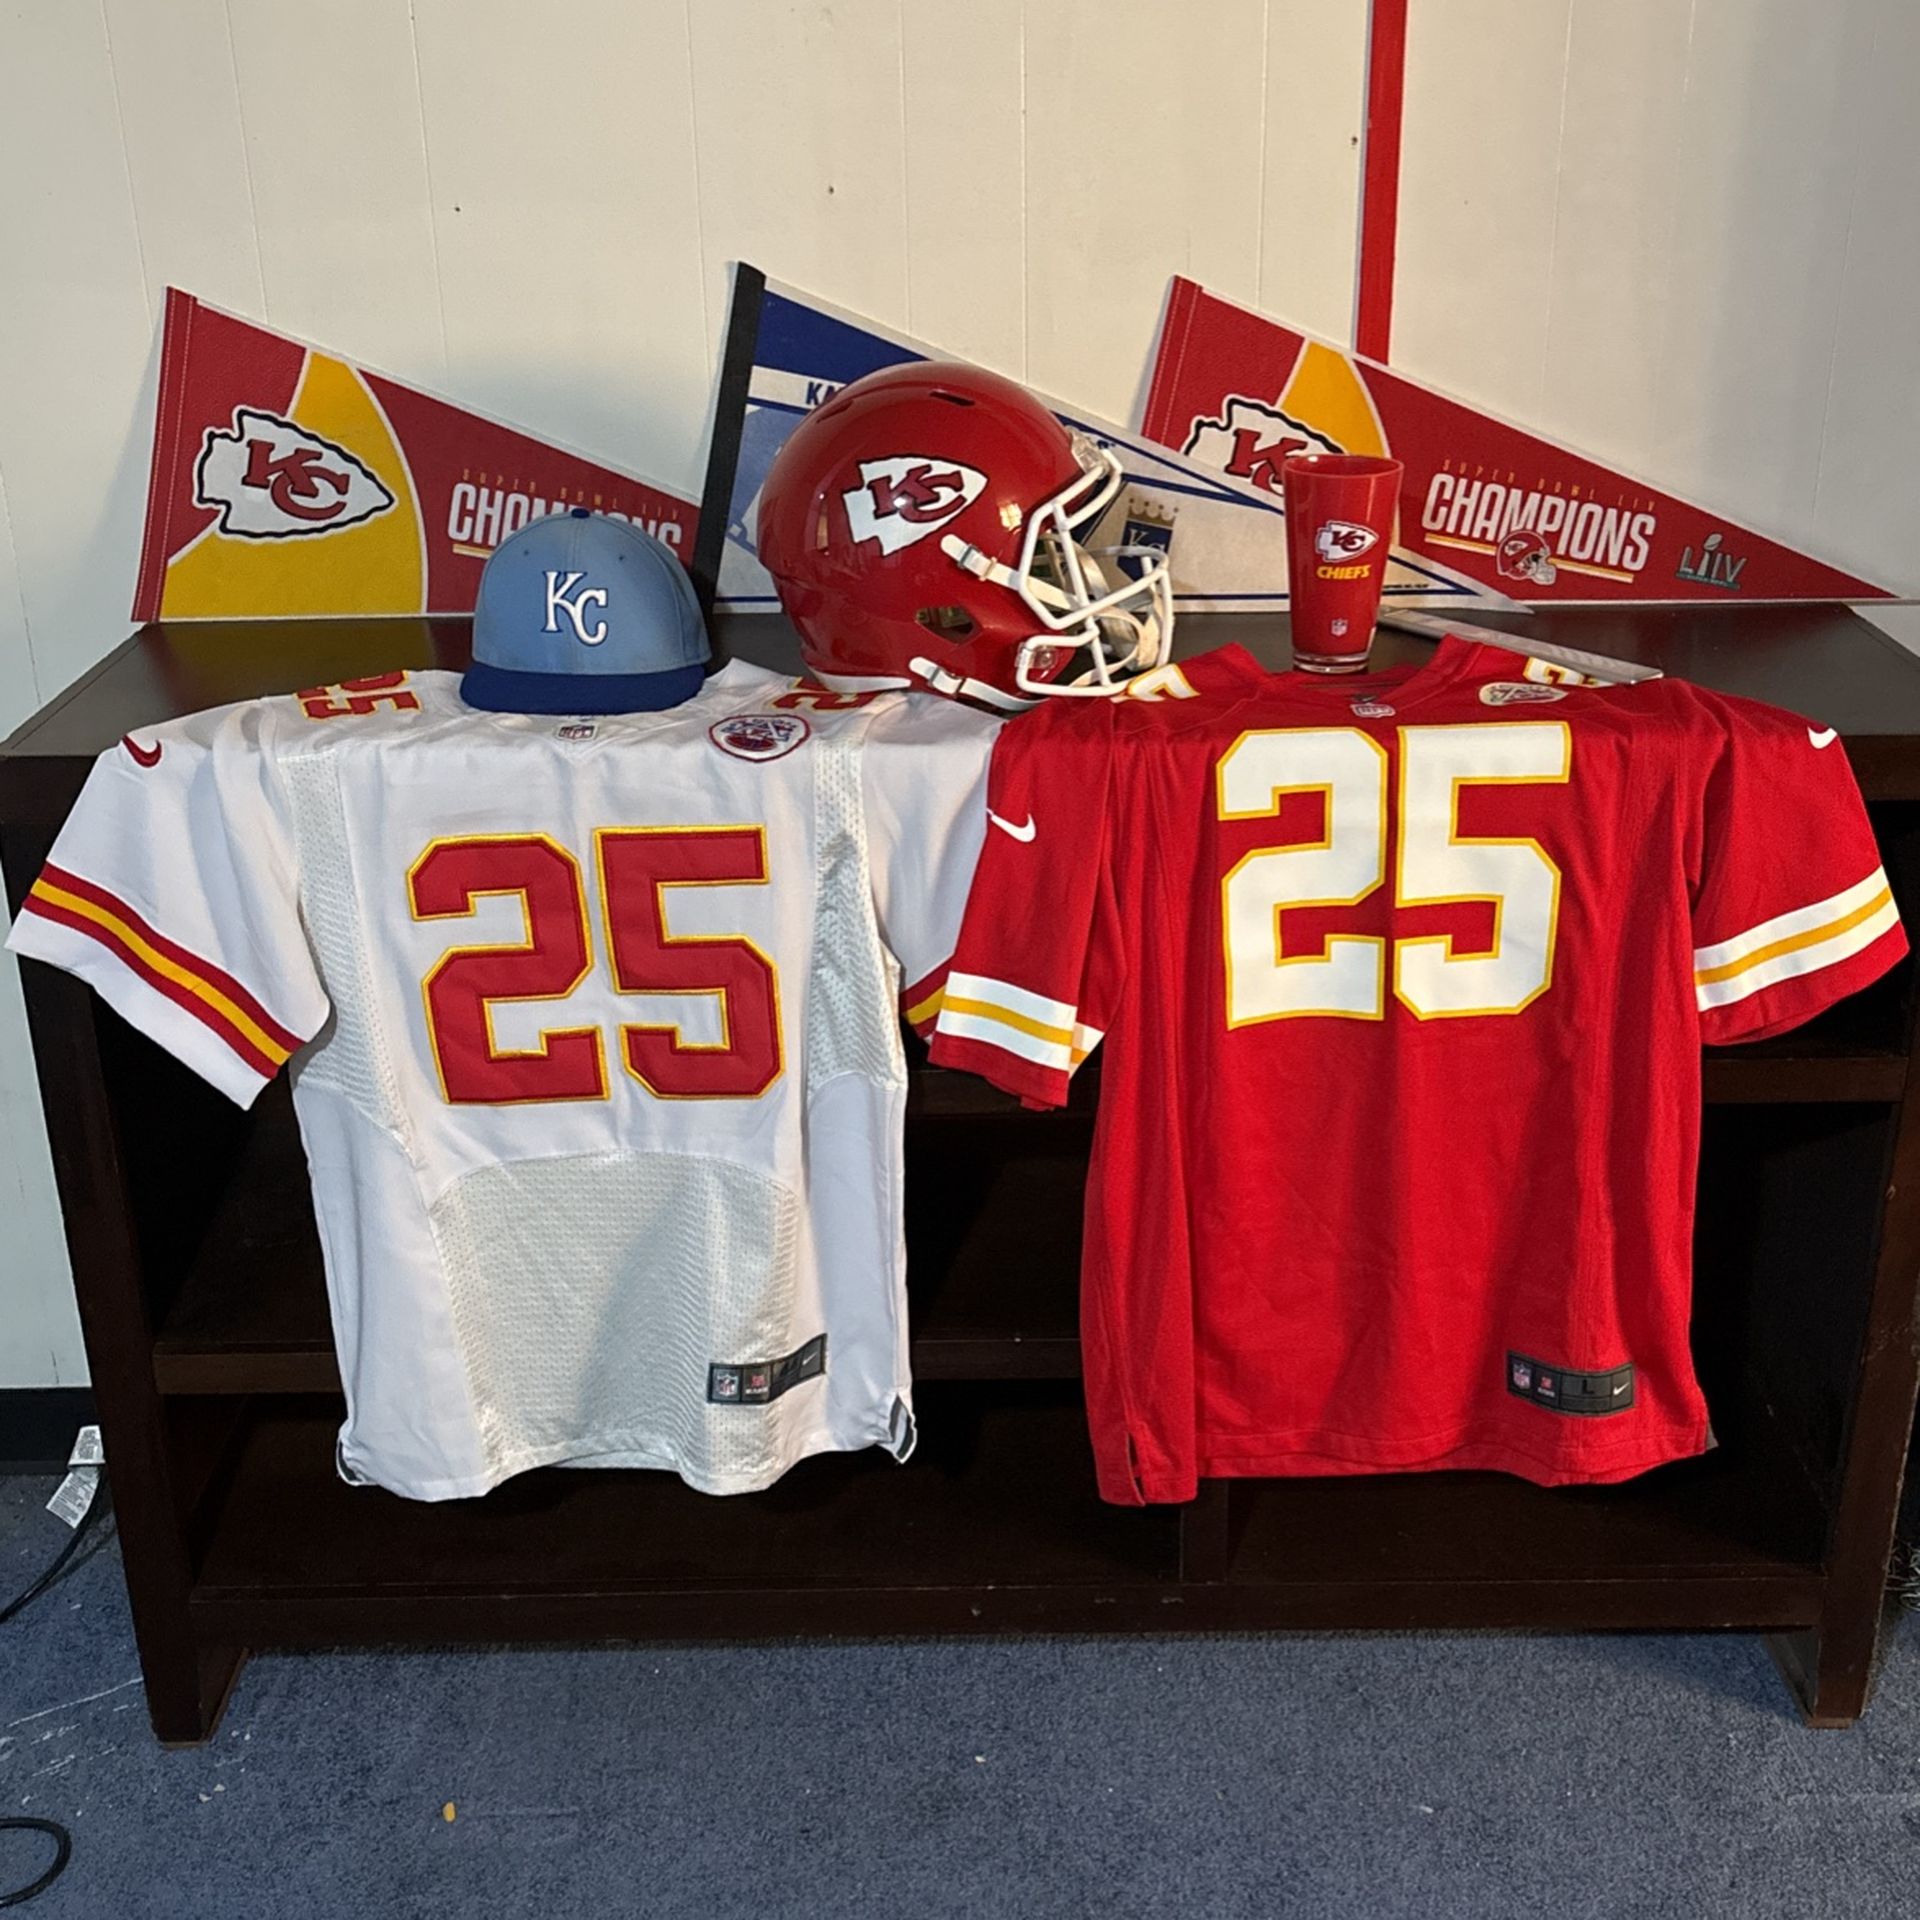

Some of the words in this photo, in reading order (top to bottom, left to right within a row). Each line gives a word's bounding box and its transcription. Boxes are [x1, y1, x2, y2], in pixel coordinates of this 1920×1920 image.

[241, 439, 350, 521] KC
[867, 464, 968, 524] KC
[1330, 530, 1366, 552] KC
[1421, 473, 1656, 571] CHAMPIONS
[541, 571, 608, 647] KC
[1316, 564, 1371, 580] CHIEFS
[1216, 721, 1571, 1030] 25
[406, 824, 784, 1104] 25
